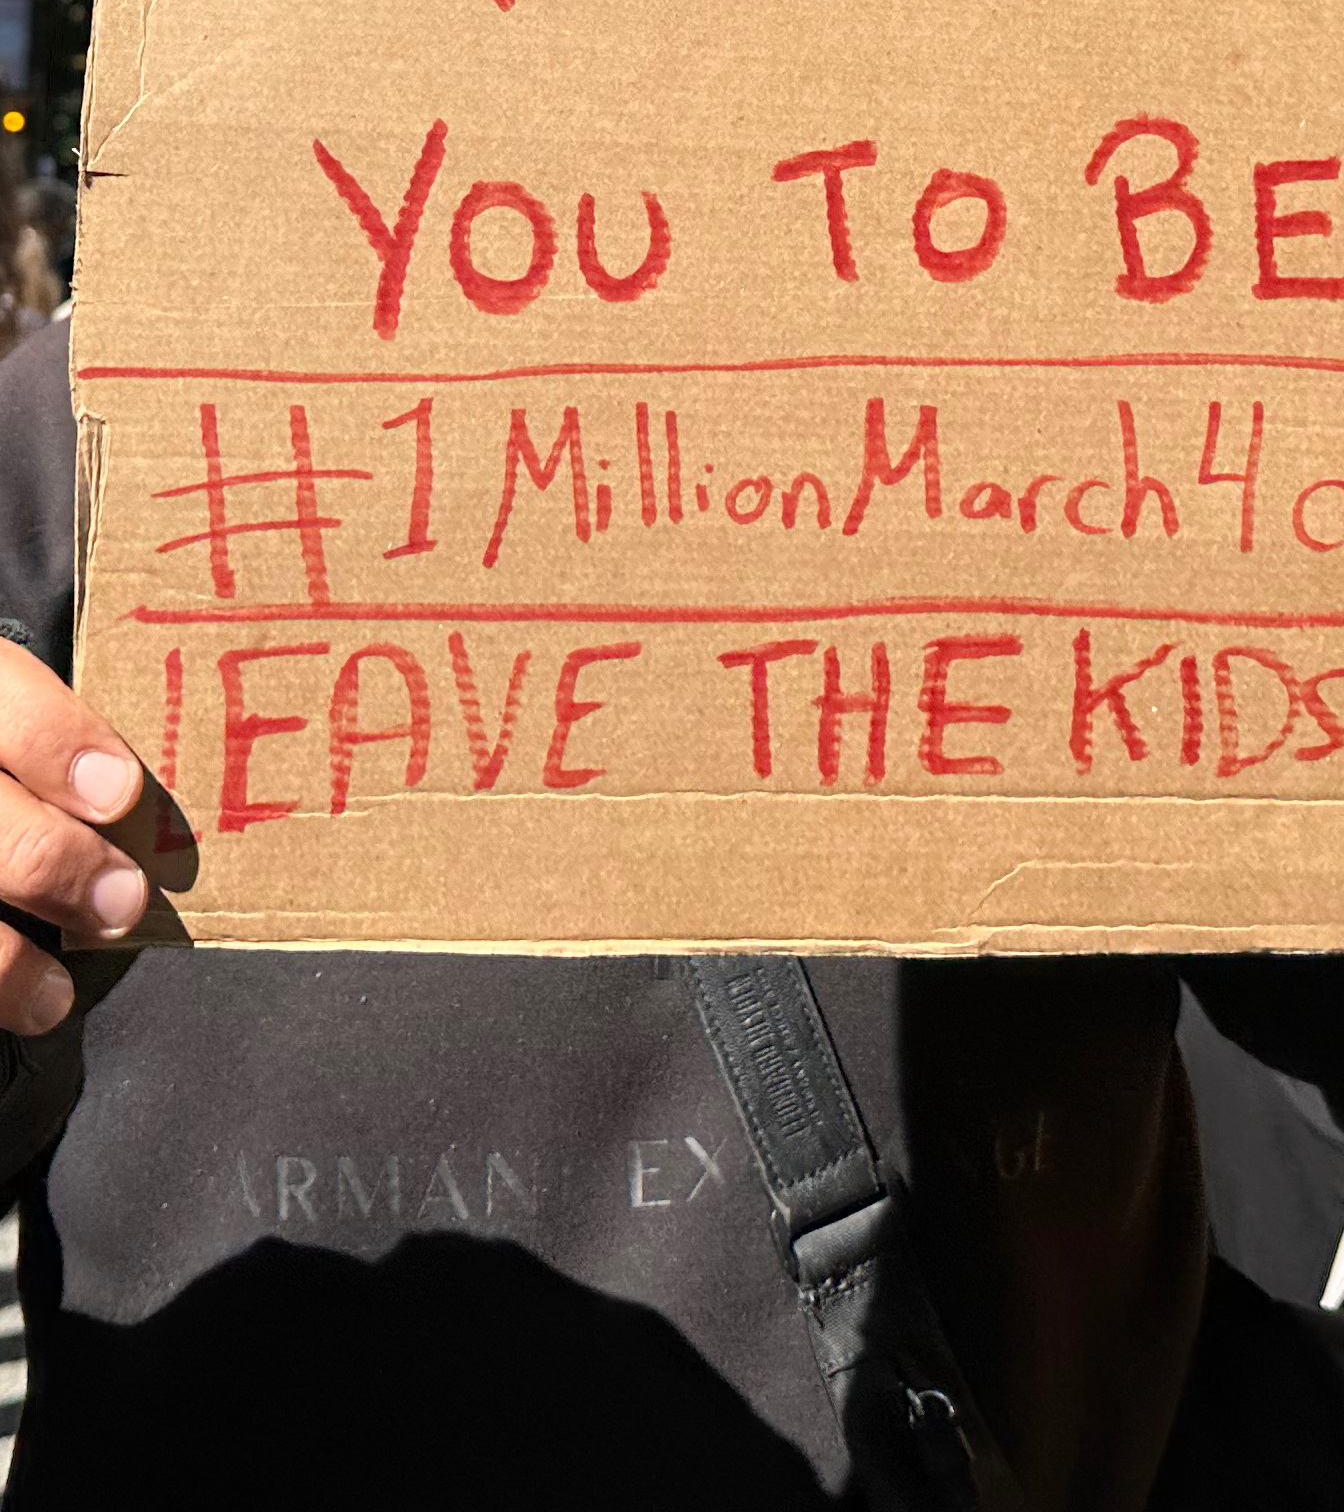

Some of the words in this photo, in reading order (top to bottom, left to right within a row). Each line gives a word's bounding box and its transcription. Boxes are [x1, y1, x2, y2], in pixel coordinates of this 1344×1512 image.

[311, 118, 672, 341] YOU
[770, 139, 1009, 284] TO
[154, 631, 643, 855] LEAVE
[718, 633, 1025, 787] THE
